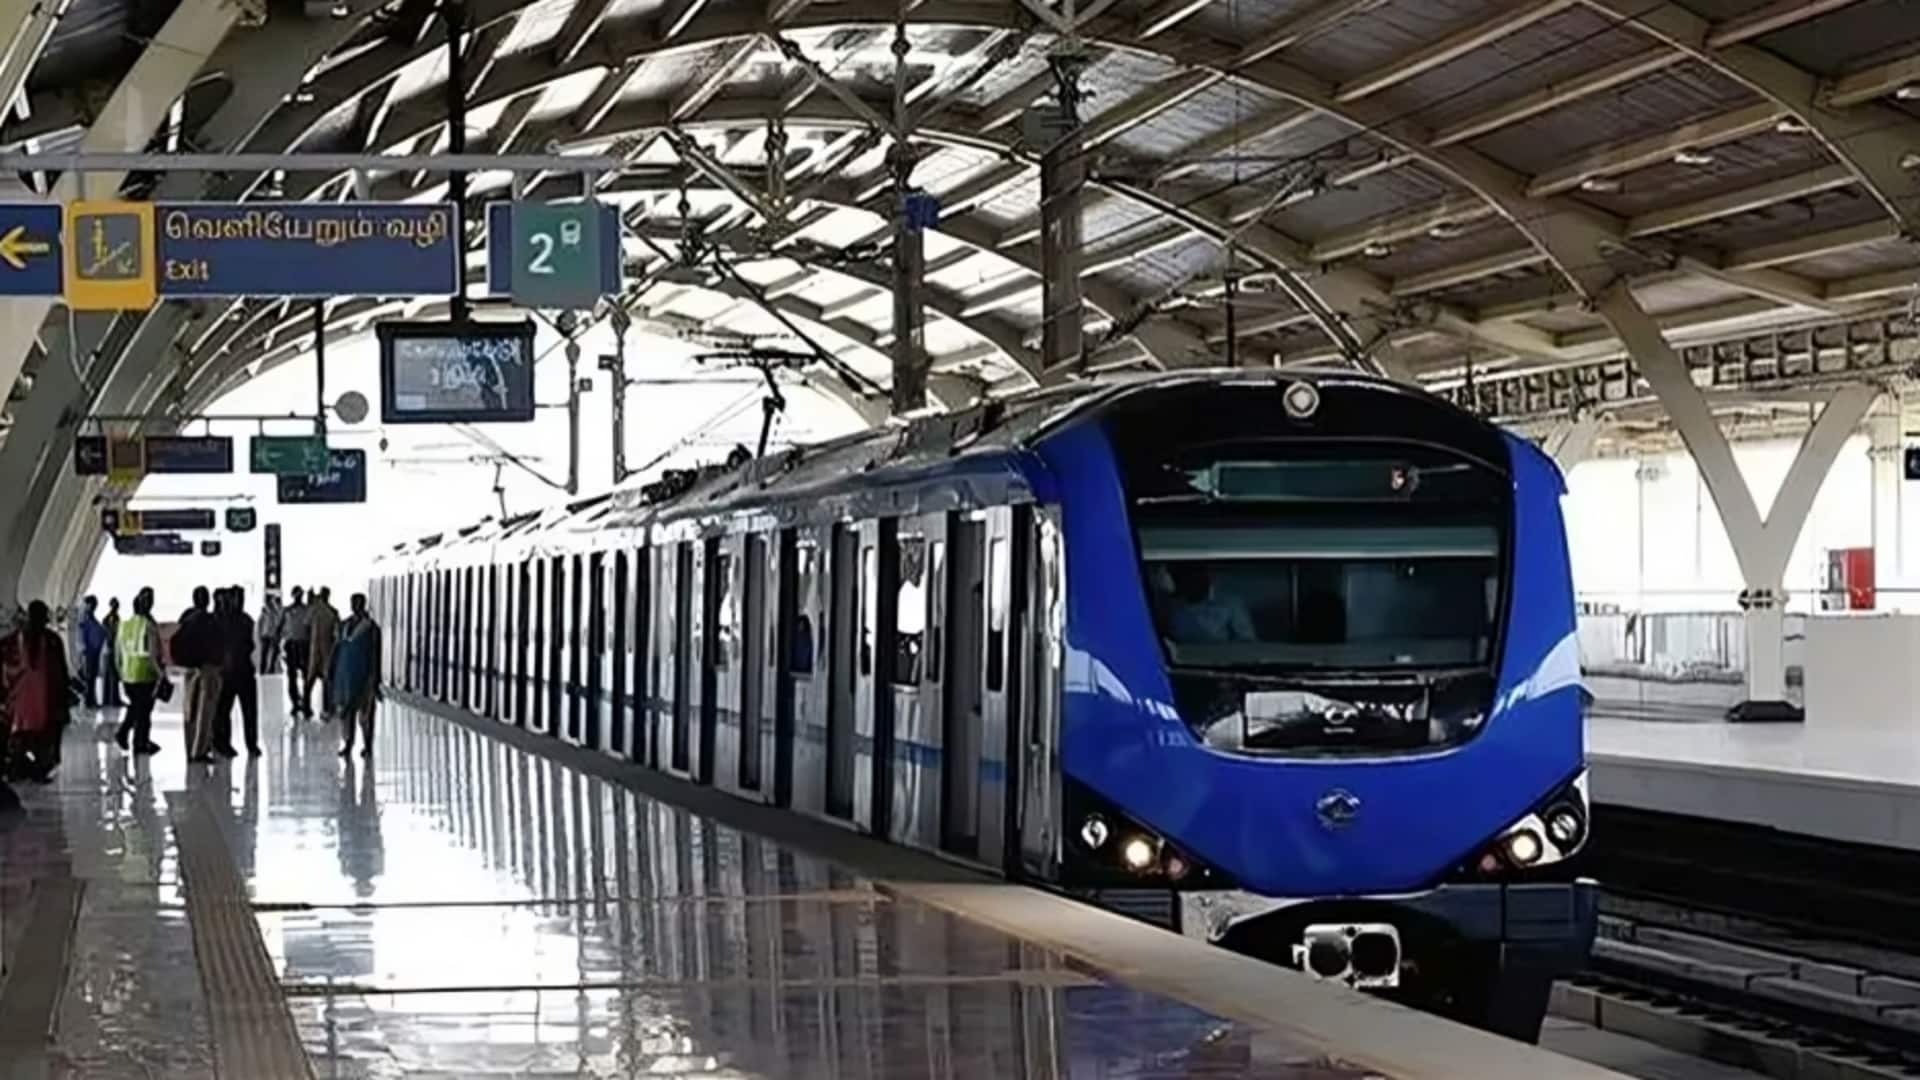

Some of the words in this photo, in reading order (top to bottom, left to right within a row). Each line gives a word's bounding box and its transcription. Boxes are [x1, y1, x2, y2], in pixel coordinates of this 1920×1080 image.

[165, 209, 373, 247] வெளியேறும்
[385, 210, 449, 248] வழி
[165, 259, 209, 281] Exit
[528, 232, 555, 274] 2
